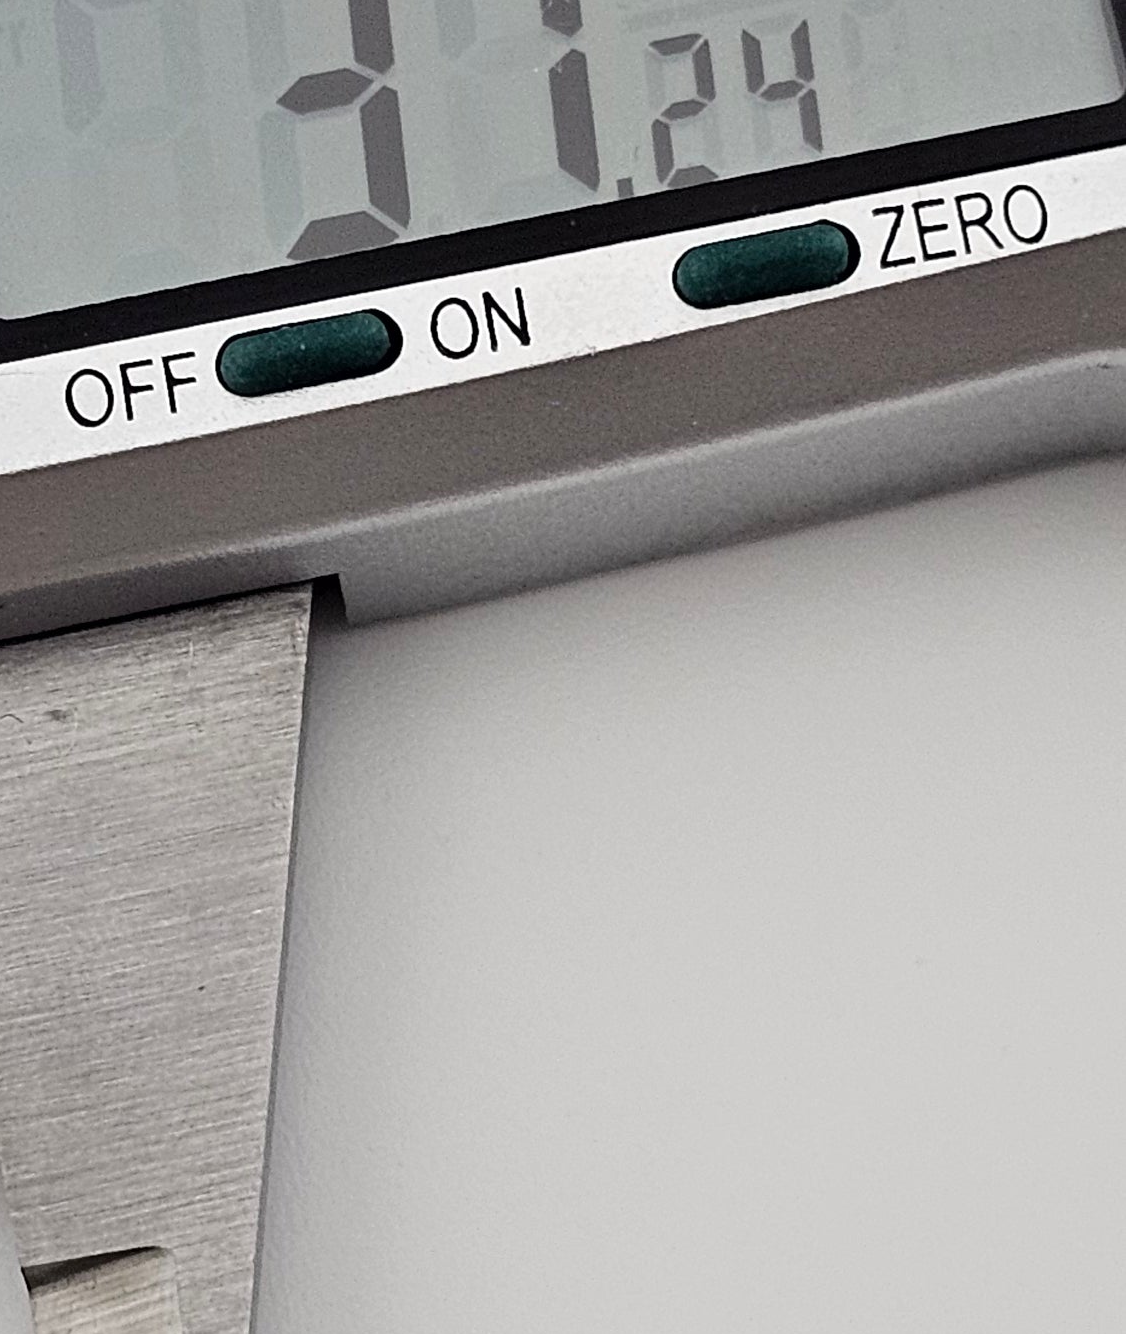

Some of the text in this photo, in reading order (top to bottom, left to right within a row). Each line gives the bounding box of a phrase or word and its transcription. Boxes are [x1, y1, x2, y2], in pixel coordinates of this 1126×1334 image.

[872, 184, 1049, 269] ZERO
[65, 287, 532, 429] OFF ON
